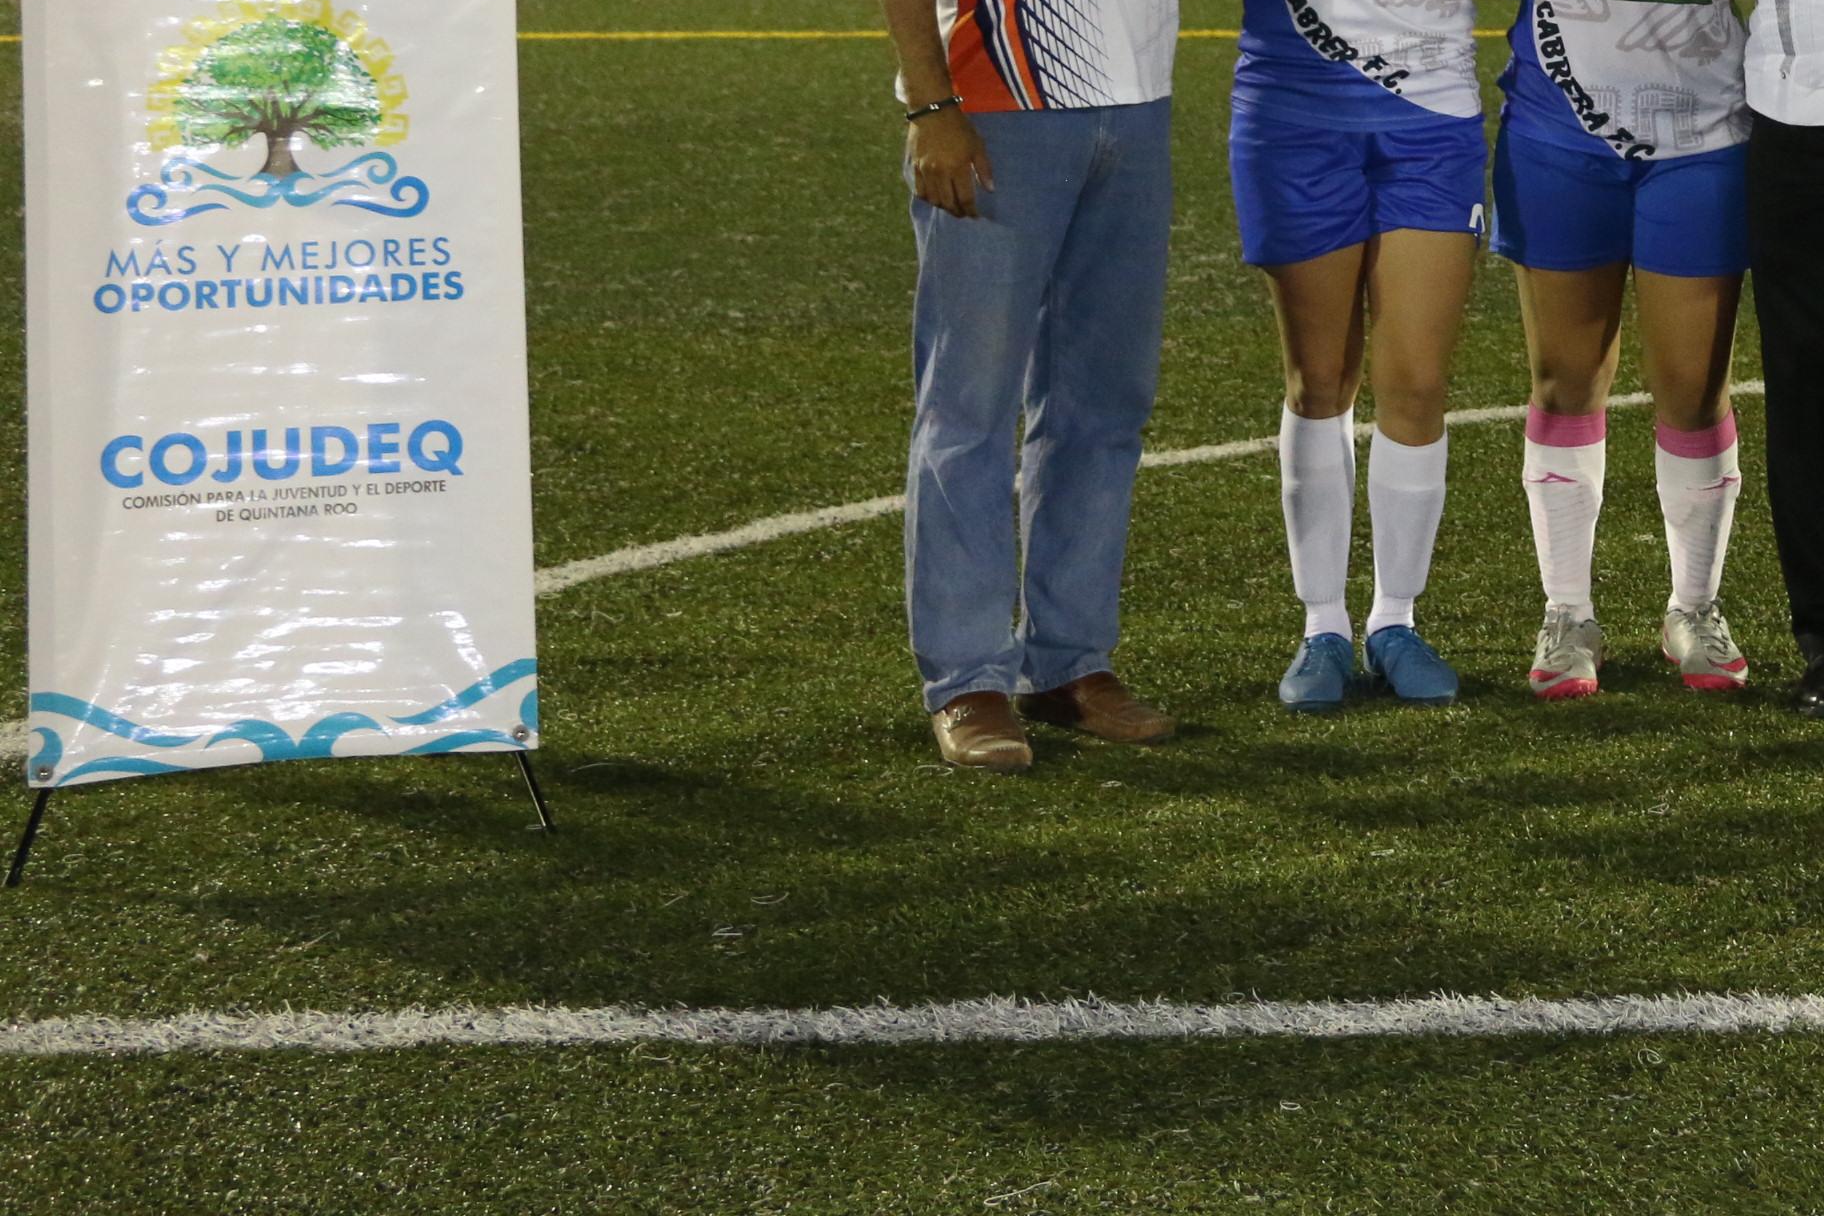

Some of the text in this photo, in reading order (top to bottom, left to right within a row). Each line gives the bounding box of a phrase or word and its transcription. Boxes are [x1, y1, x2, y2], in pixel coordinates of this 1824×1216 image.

[1362, 55, 1410, 95] F.C.
[1536, 1, 1610, 132] CABRERA
[105, 236, 452, 277] MÁS Y MEJORES
[93, 271, 465, 314] OPORTUNIDADES
[100, 419, 465, 489] COJUDEQ
[122, 480, 447, 510] COMISIÓN PARA LA JUVENTUD Y EL DEPORTE
[216, 502, 358, 522] DE QUINTANA ROO
